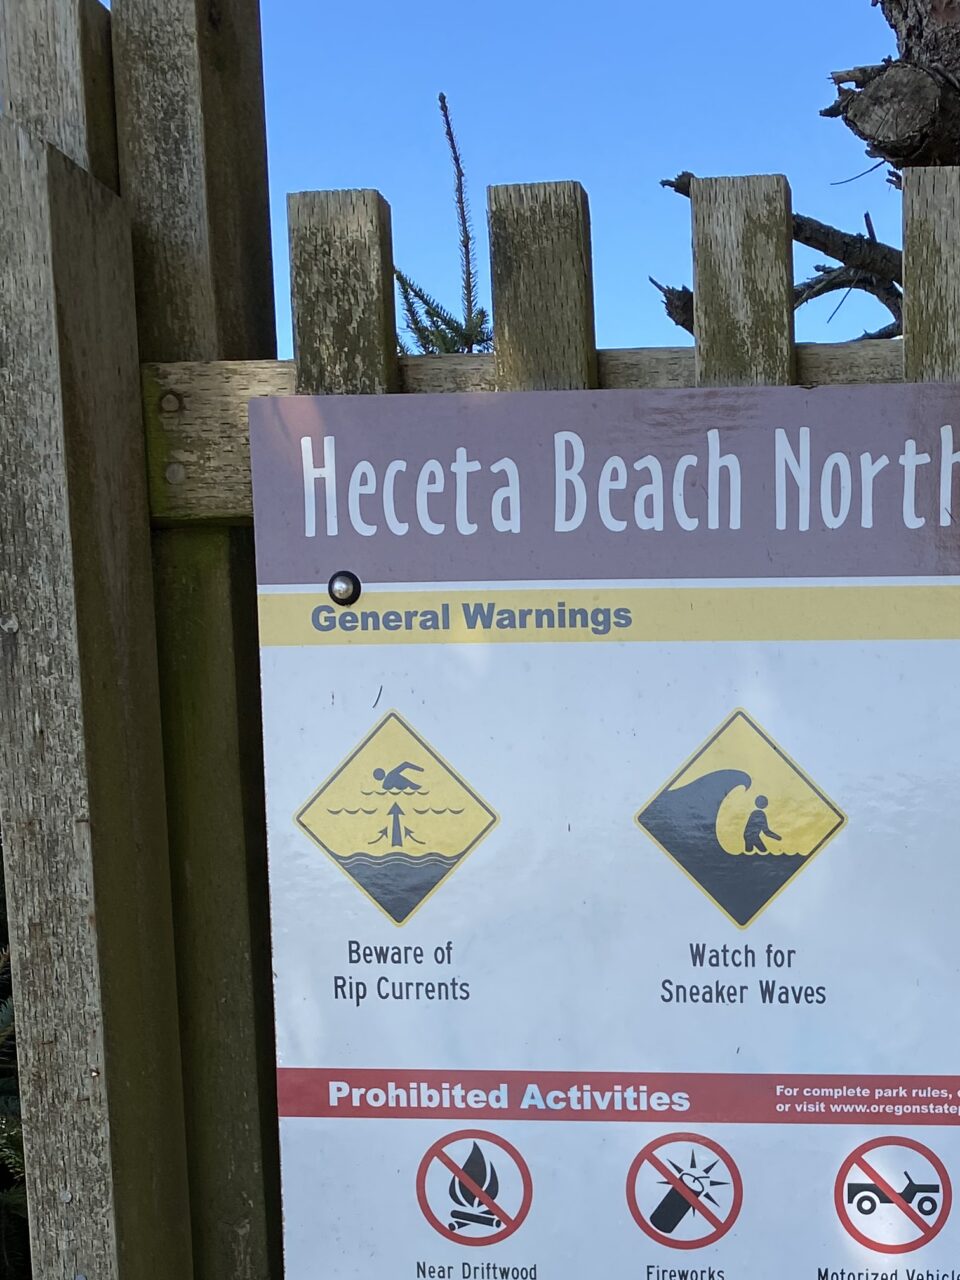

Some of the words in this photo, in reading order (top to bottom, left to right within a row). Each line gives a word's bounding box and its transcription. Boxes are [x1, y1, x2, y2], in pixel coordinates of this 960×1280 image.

[300, 436, 521, 537] Heceta
[554, 431, 742, 533] Beach
[311, 600, 449, 631] General
[461, 601, 632, 635] Warnings
[348, 940, 423, 964] Beware
[433, 940, 452, 964] of
[689, 943, 755, 967] Watch
[765, 943, 796, 968] for
[333, 975, 367, 1007] Rip
[376, 976, 470, 1000] Currents
[660, 978, 748, 1003] Sneaker
[758, 980, 826, 1004] Waves
[328, 1081, 508, 1108] Prohibited
[519, 1083, 690, 1111] Activities
[776, 1084, 799, 1096] For
[803, 1085, 870, 1098] complete
[874, 1086, 907, 1099] park
[911, 1086, 952, 1099] rules,
[775, 1103, 791, 1112] or
[794, 1101, 825, 1112] visit
[416, 1261, 453, 1279] Near
[461, 1262, 536, 1280] Driftwood
